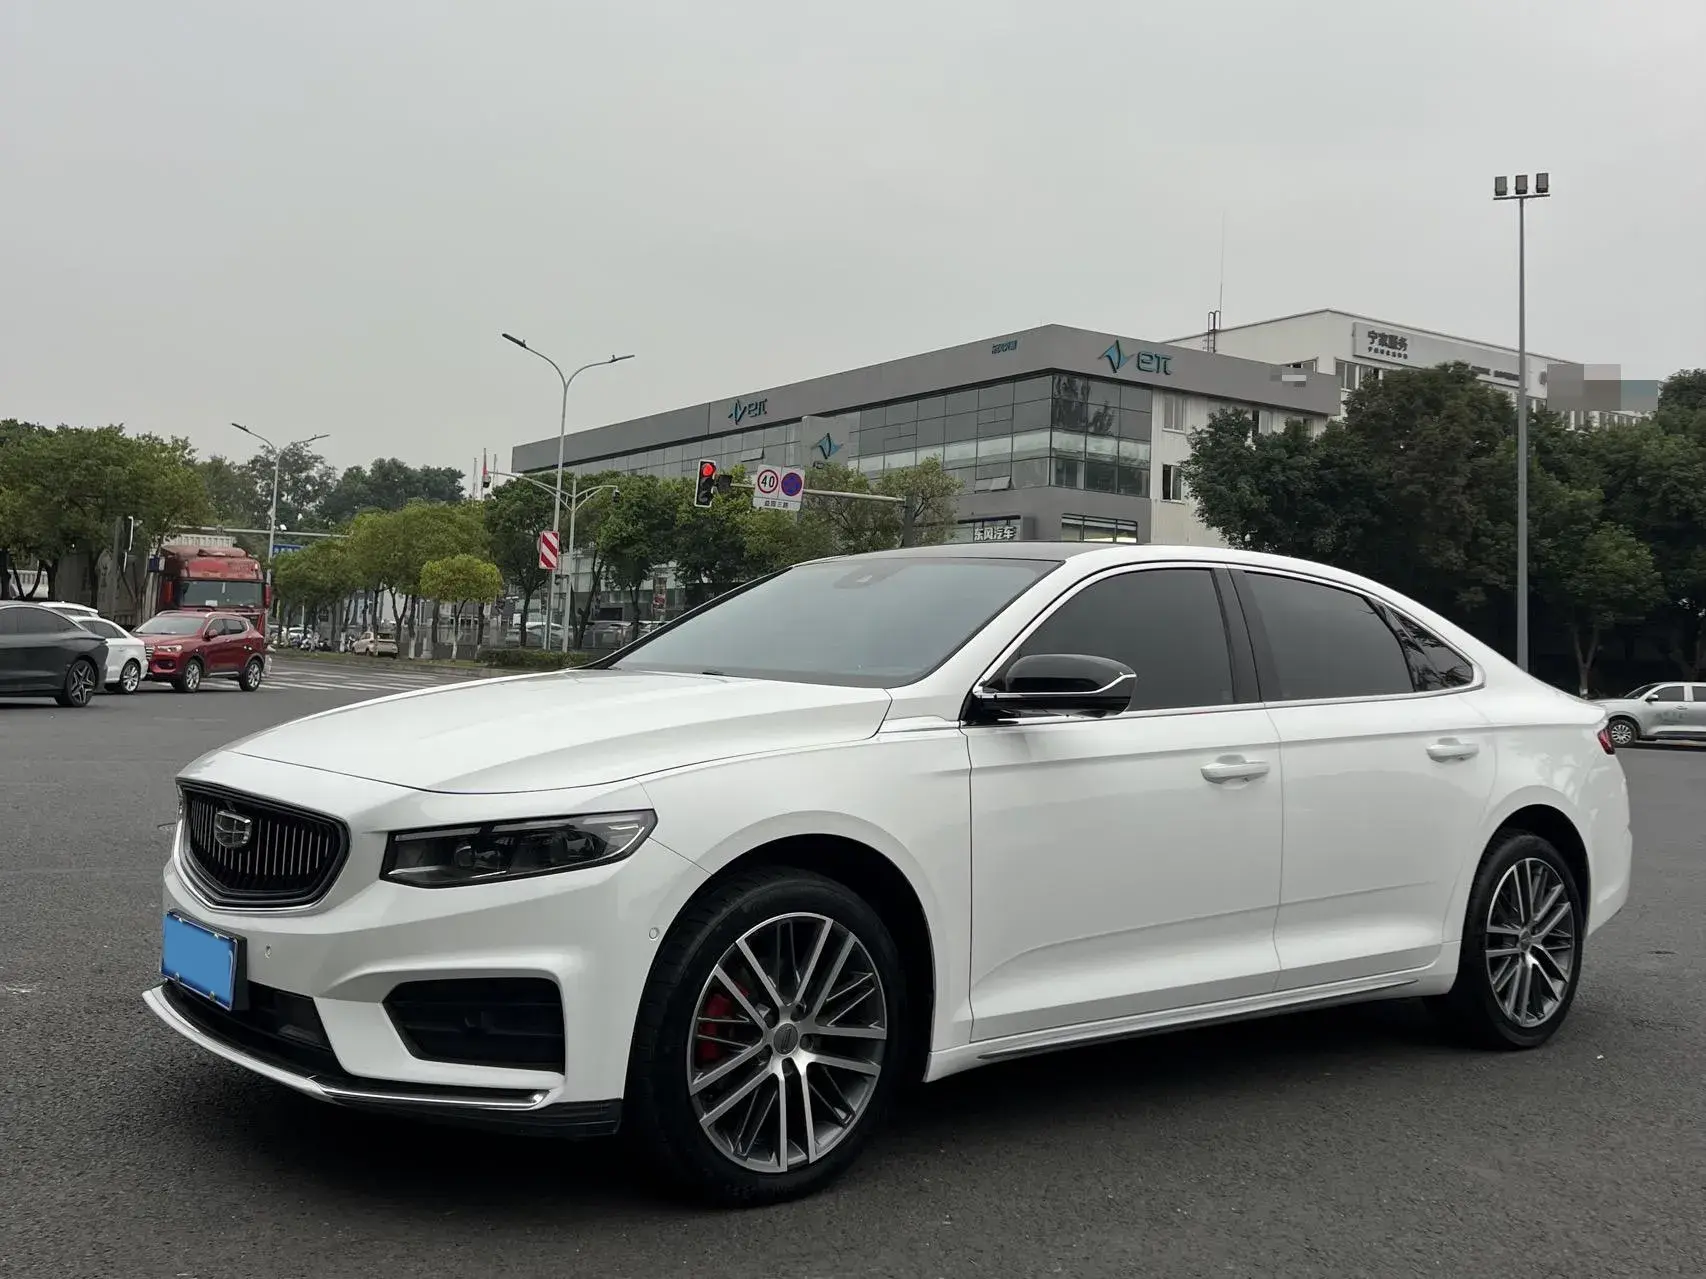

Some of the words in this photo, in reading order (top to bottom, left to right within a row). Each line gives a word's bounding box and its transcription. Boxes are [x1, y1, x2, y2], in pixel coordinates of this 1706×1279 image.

[761, 475, 775, 488] 40
[974, 526, 1015, 541] 东风汽车
